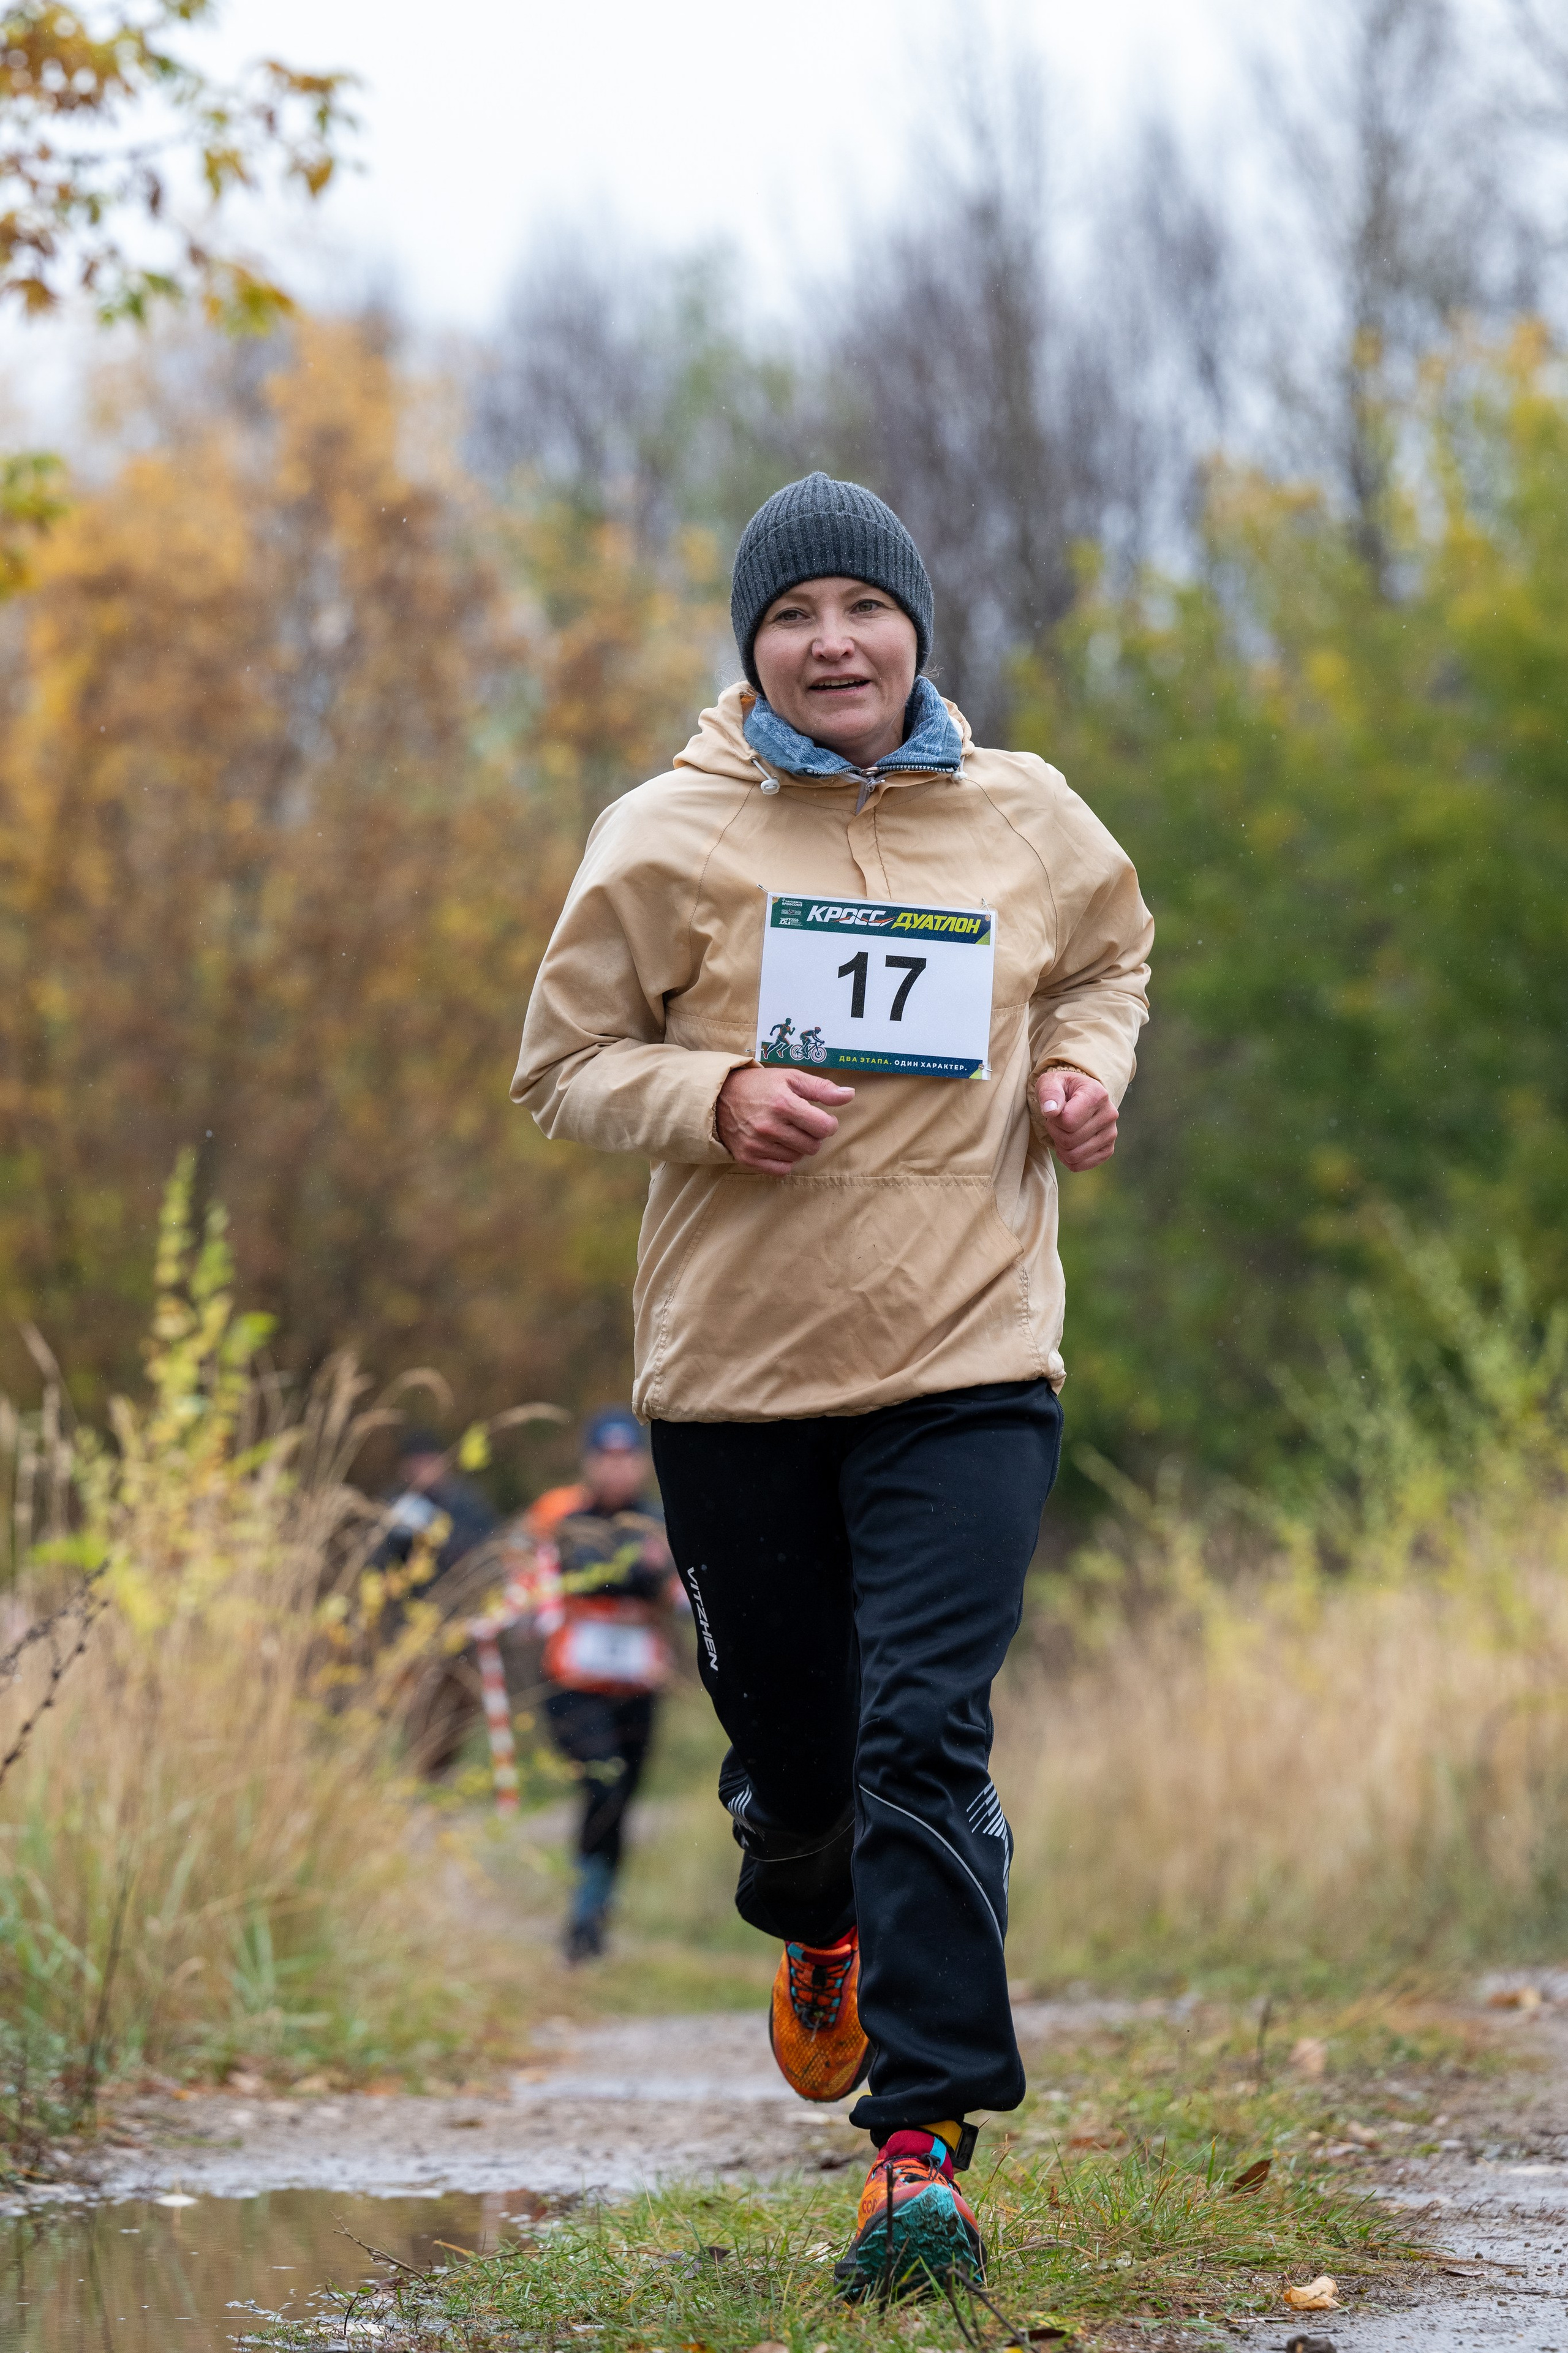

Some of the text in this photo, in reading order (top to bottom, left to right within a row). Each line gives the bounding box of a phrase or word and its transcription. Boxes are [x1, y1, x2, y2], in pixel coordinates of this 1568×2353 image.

[806, 905, 981, 934] КРОСС ДУАТЛОН
[837, 951, 927, 1021] 17
[921, 1062, 967, 1071] ХАРАКТЕР.
